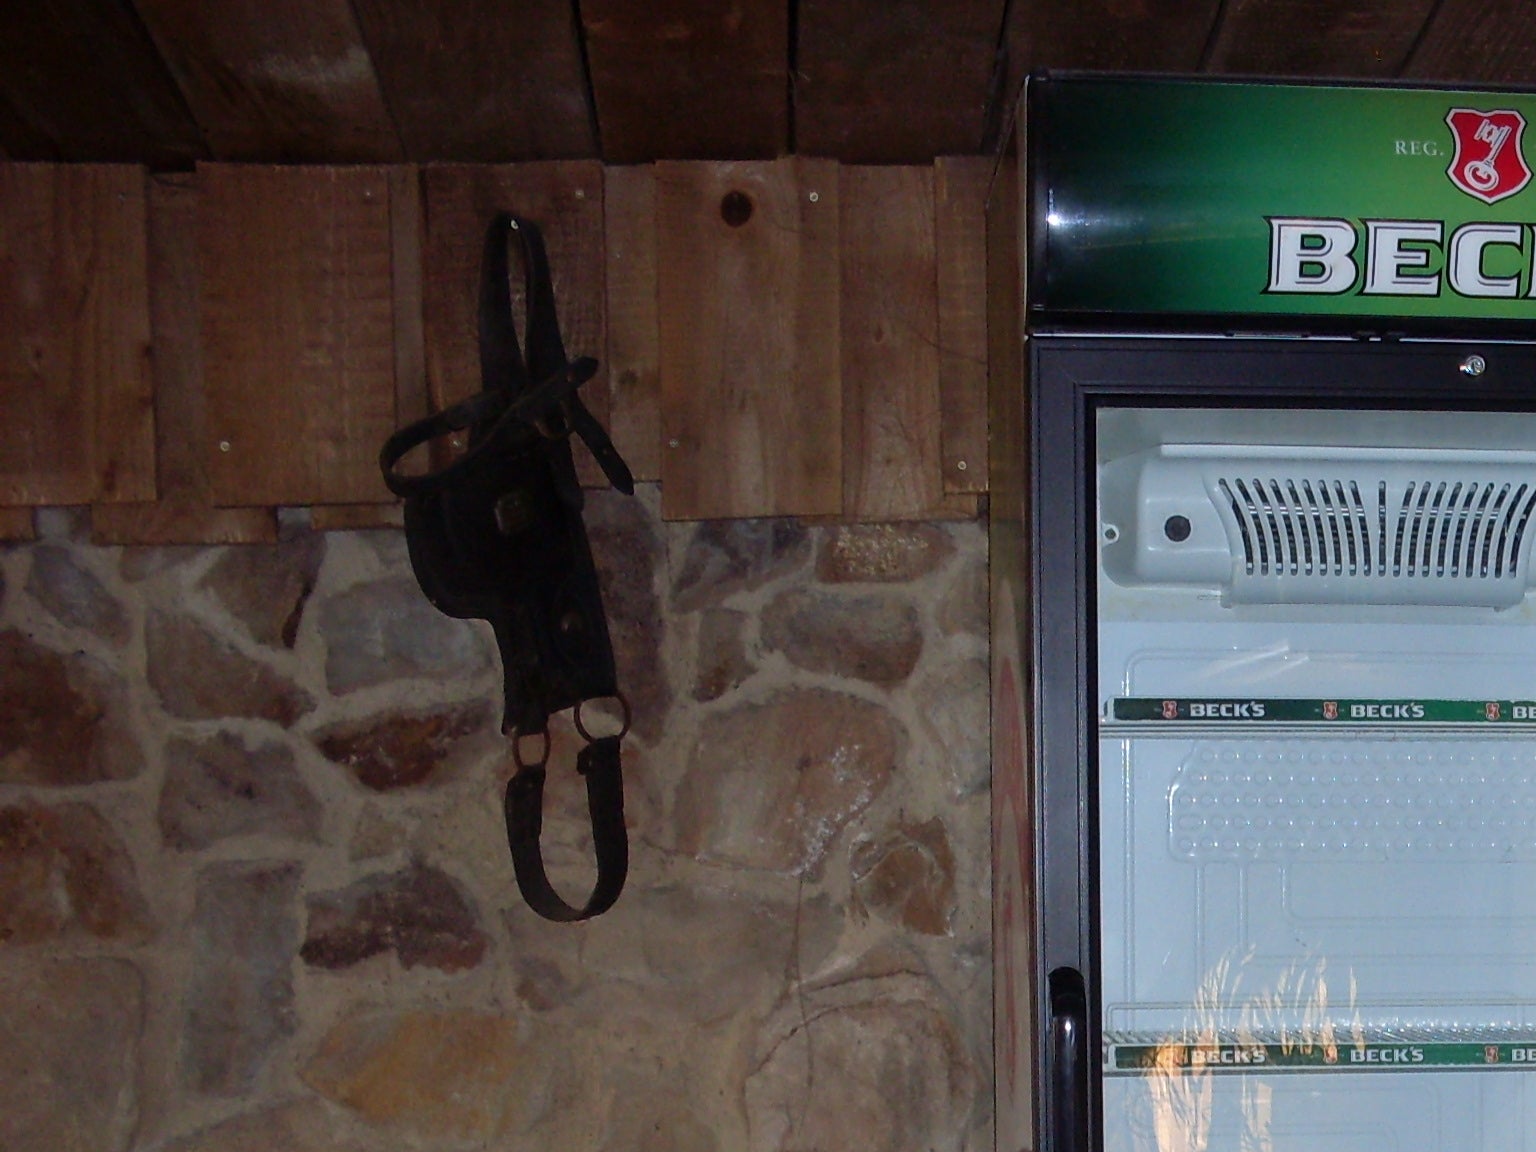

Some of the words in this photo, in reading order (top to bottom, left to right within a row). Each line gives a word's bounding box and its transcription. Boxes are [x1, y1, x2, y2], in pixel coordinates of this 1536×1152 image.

[1394, 140, 1445, 157] REG.
[1190, 701, 1265, 718] BECK'S
[1350, 702, 1425, 719] BECK'S
[1191, 1047, 1266, 1064] BECK'S
[1351, 1046, 1424, 1063] BECK'S
